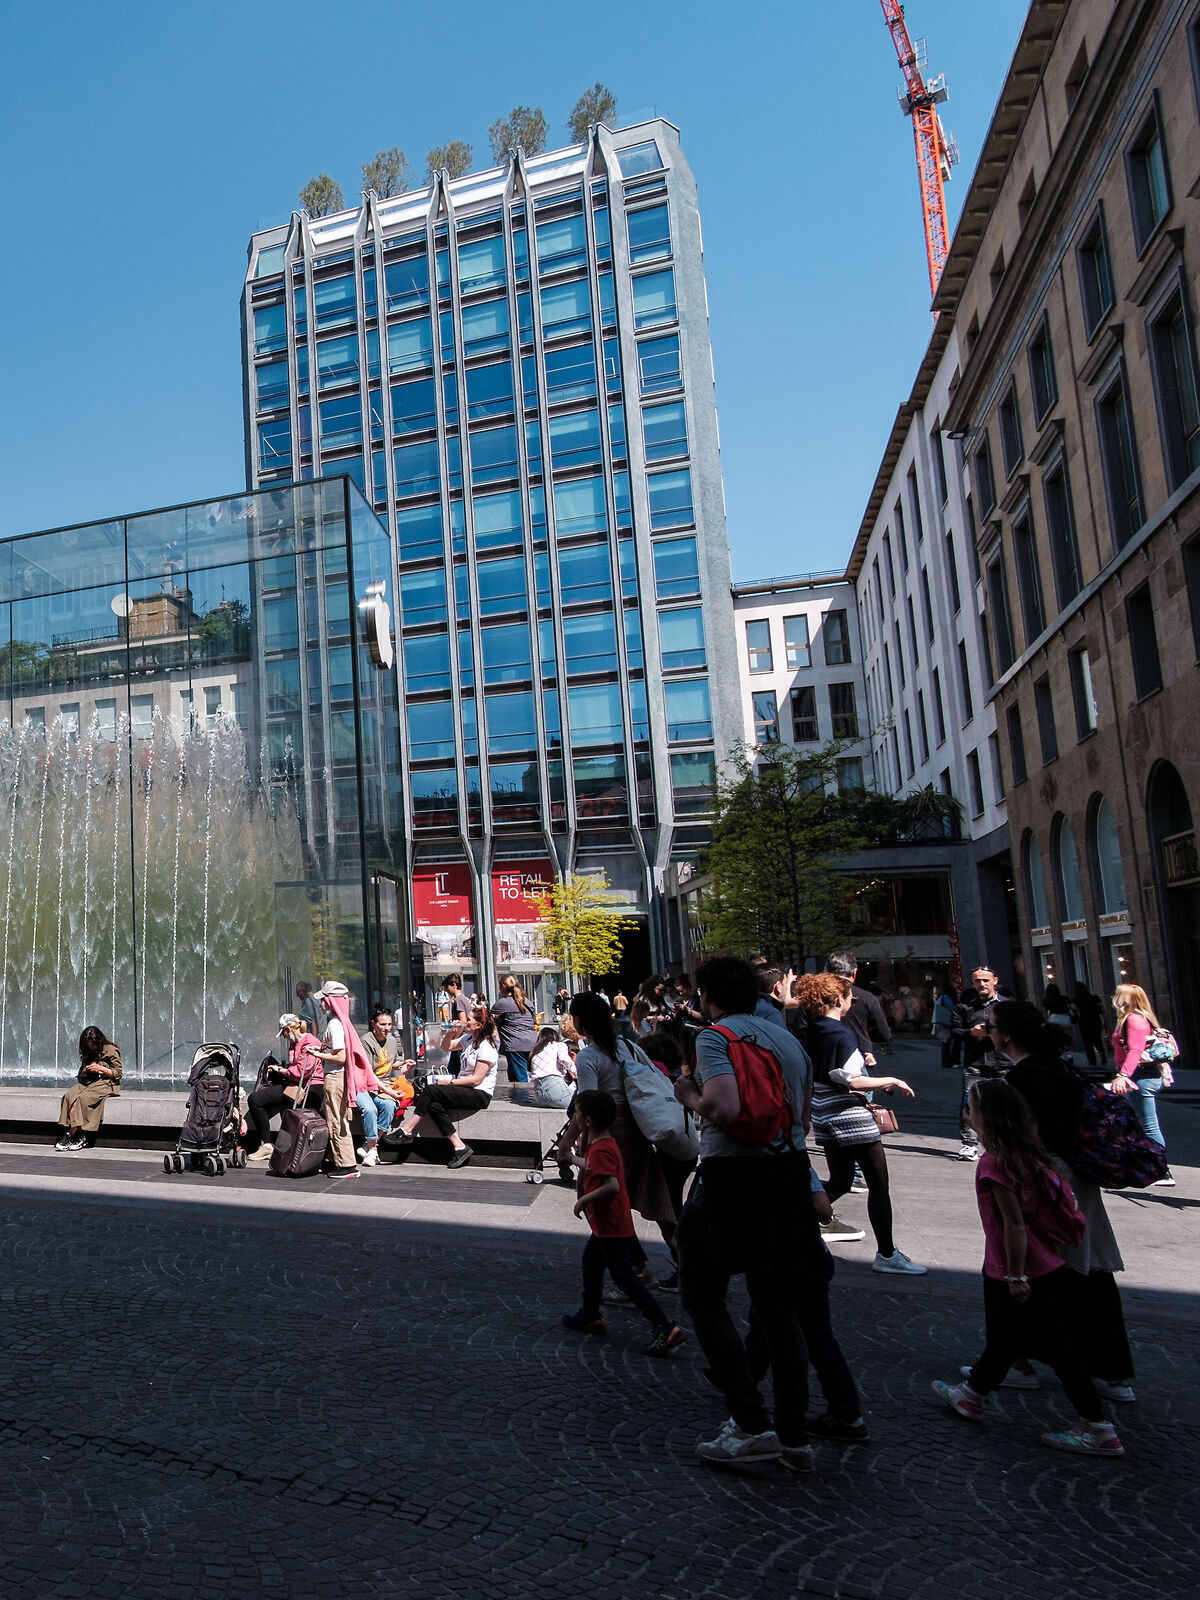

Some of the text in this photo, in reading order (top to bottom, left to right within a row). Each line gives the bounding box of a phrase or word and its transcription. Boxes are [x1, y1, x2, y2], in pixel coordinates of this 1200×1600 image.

[499, 873, 546, 887] RETAIL
[498, 887, 520, 900] TO
[522, 886, 549, 898] LET
